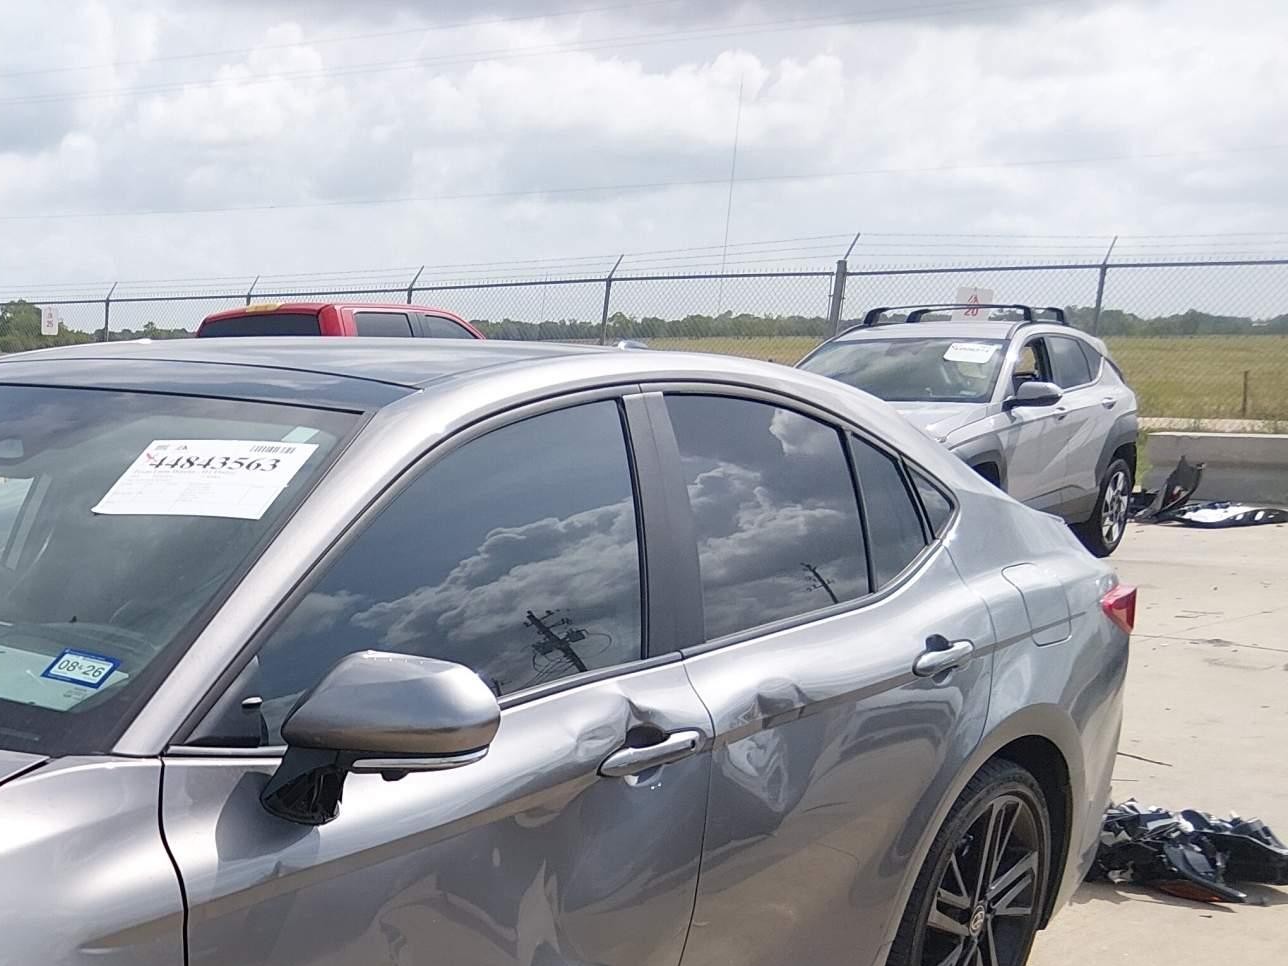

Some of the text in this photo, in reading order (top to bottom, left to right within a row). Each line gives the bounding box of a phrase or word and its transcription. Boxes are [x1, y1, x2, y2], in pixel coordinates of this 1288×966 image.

[149, 456, 281, 472] 44843563
[58, 660, 80, 672] 08
[82, 665, 105, 678] 26
